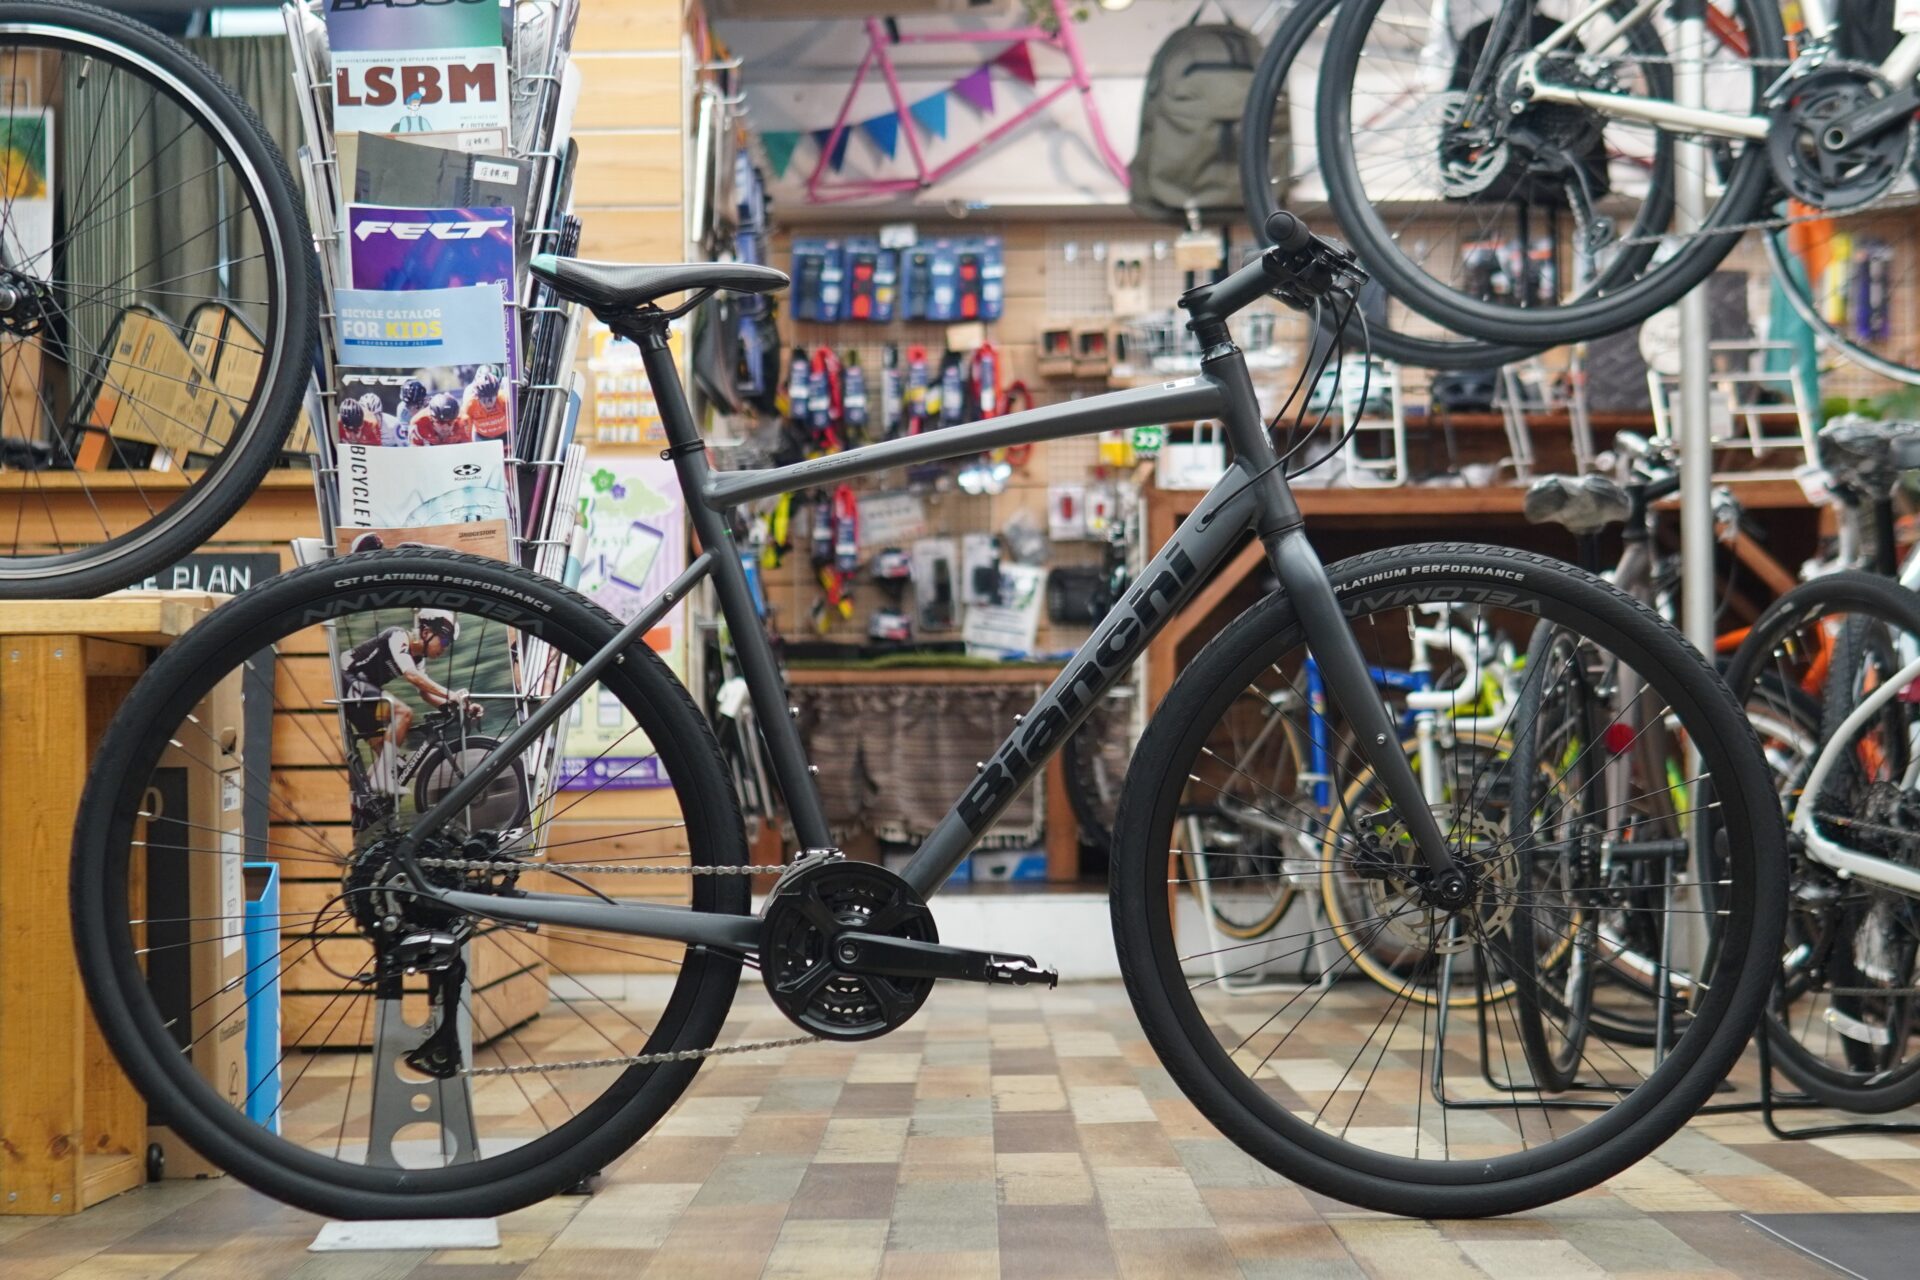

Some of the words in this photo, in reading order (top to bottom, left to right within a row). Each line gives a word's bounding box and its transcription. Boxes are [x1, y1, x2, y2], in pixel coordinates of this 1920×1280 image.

[336, 63, 497, 107] LSBM
[354, 220, 508, 242] FELT
[341, 308, 385, 319] BICYCLE
[386, 308, 441, 319] CATALOG
[342, 321, 380, 338] FOR
[385, 320, 443, 338] KIDS
[350, 445, 371, 517] BICYCLE
[172, 564, 252, 593] PLAN
[334, 576, 358, 588] CST
[363, 573, 440, 584] PLATINUM
[443, 575, 552, 613] PERFORMANCE
[1333, 567, 1407, 594] PLATINUM
[1411, 564, 1526, 582] PERFORMANCE
[955, 541, 1198, 836] Bianchi
